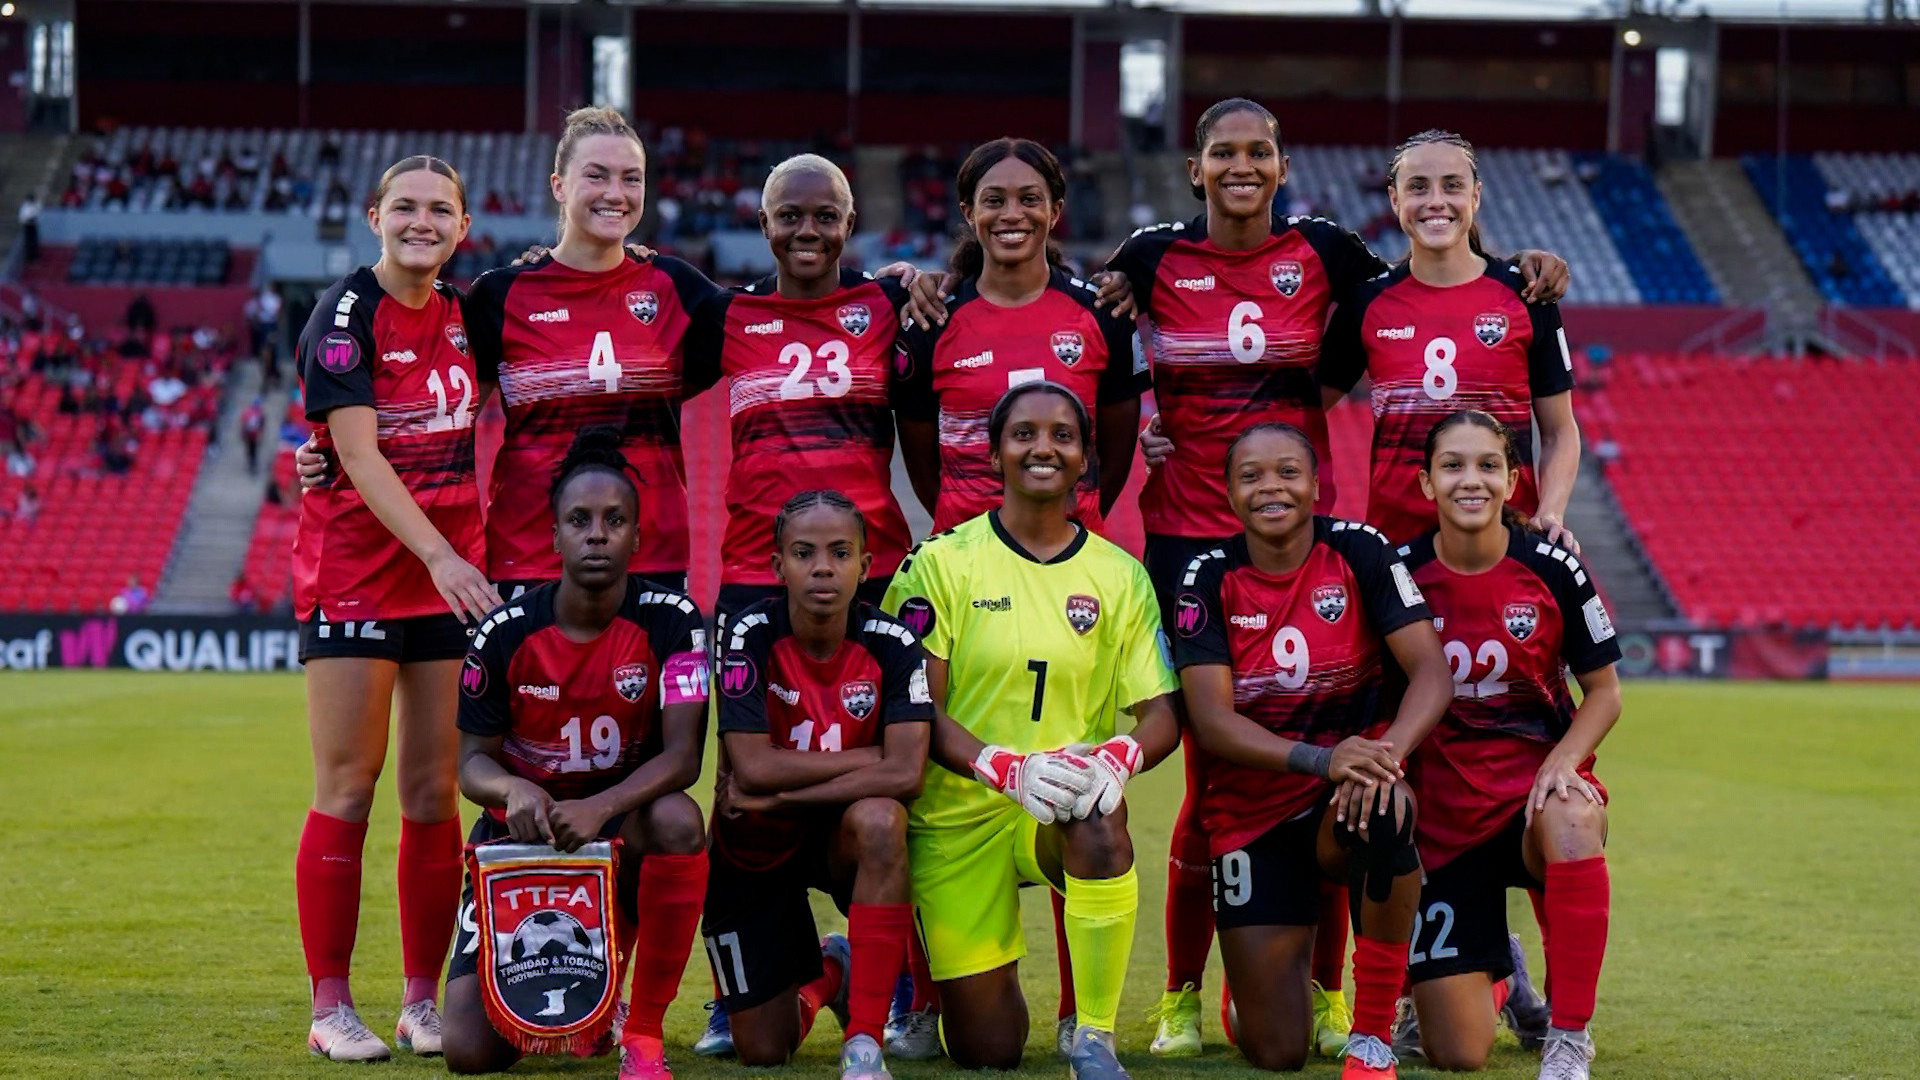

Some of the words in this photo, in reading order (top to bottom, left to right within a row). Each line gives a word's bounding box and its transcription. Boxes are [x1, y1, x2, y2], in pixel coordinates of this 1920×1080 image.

[1228, 301, 1266, 363] 6
[589, 332, 622, 393] 4
[777, 340, 852, 399] 23
[1422, 337, 1458, 399] 8
[426, 365, 473, 431] 12
[0, 630, 52, 670] af
[1271, 626, 1310, 688] 9
[1443, 639, 1510, 699] 22
[1027, 659, 1048, 722] 1
[560, 715, 621, 773] 19
[501, 884, 593, 911] TTFA
[1222, 848, 1252, 906] 9
[1408, 901, 1459, 966] 22
[499, 957, 549, 978] TRINIDAD
[552, 956, 560, 966] &
[562, 956, 604, 972] TOBAGO
[506, 967, 546, 986] FOOTBALL
